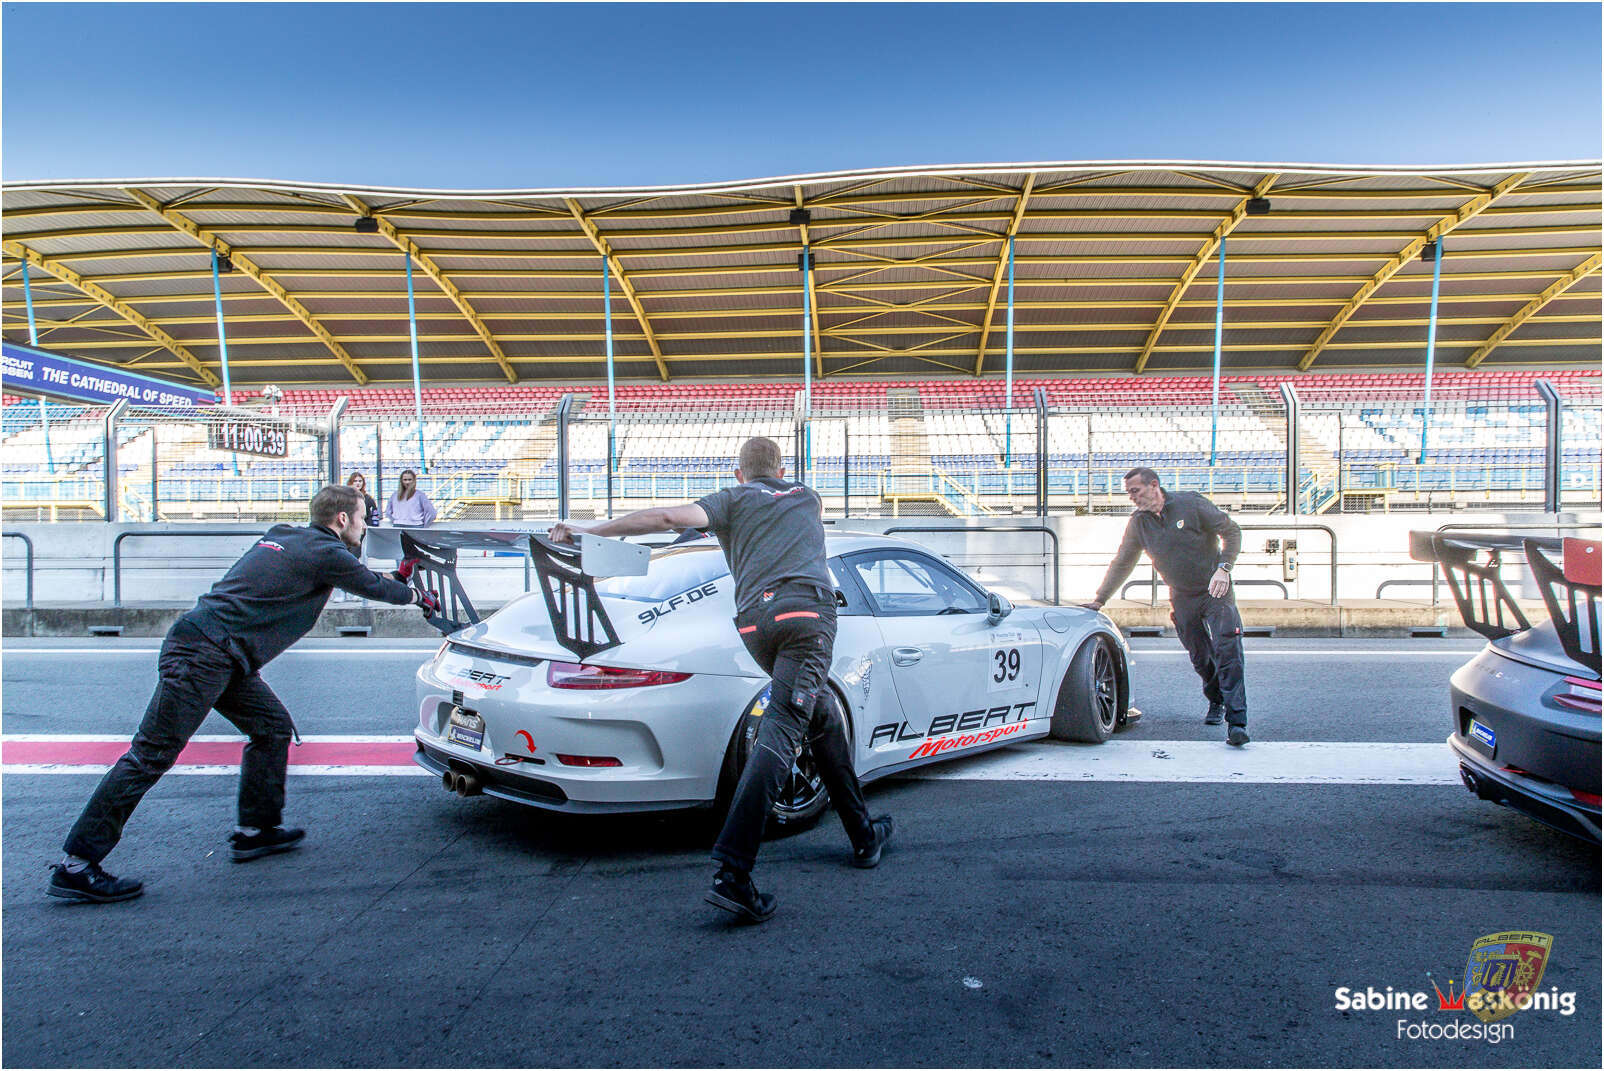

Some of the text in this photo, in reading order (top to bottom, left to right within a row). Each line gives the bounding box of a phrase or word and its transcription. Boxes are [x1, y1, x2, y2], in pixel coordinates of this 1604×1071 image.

[42, 366, 192, 407] THE CATHEDRAL OF SPEED
[220, 423, 286, 456] 11:00:39
[993, 648, 1021, 684] 39
[868, 702, 1036, 748] ALBERT
[908, 718, 1028, 759] Motorsport
